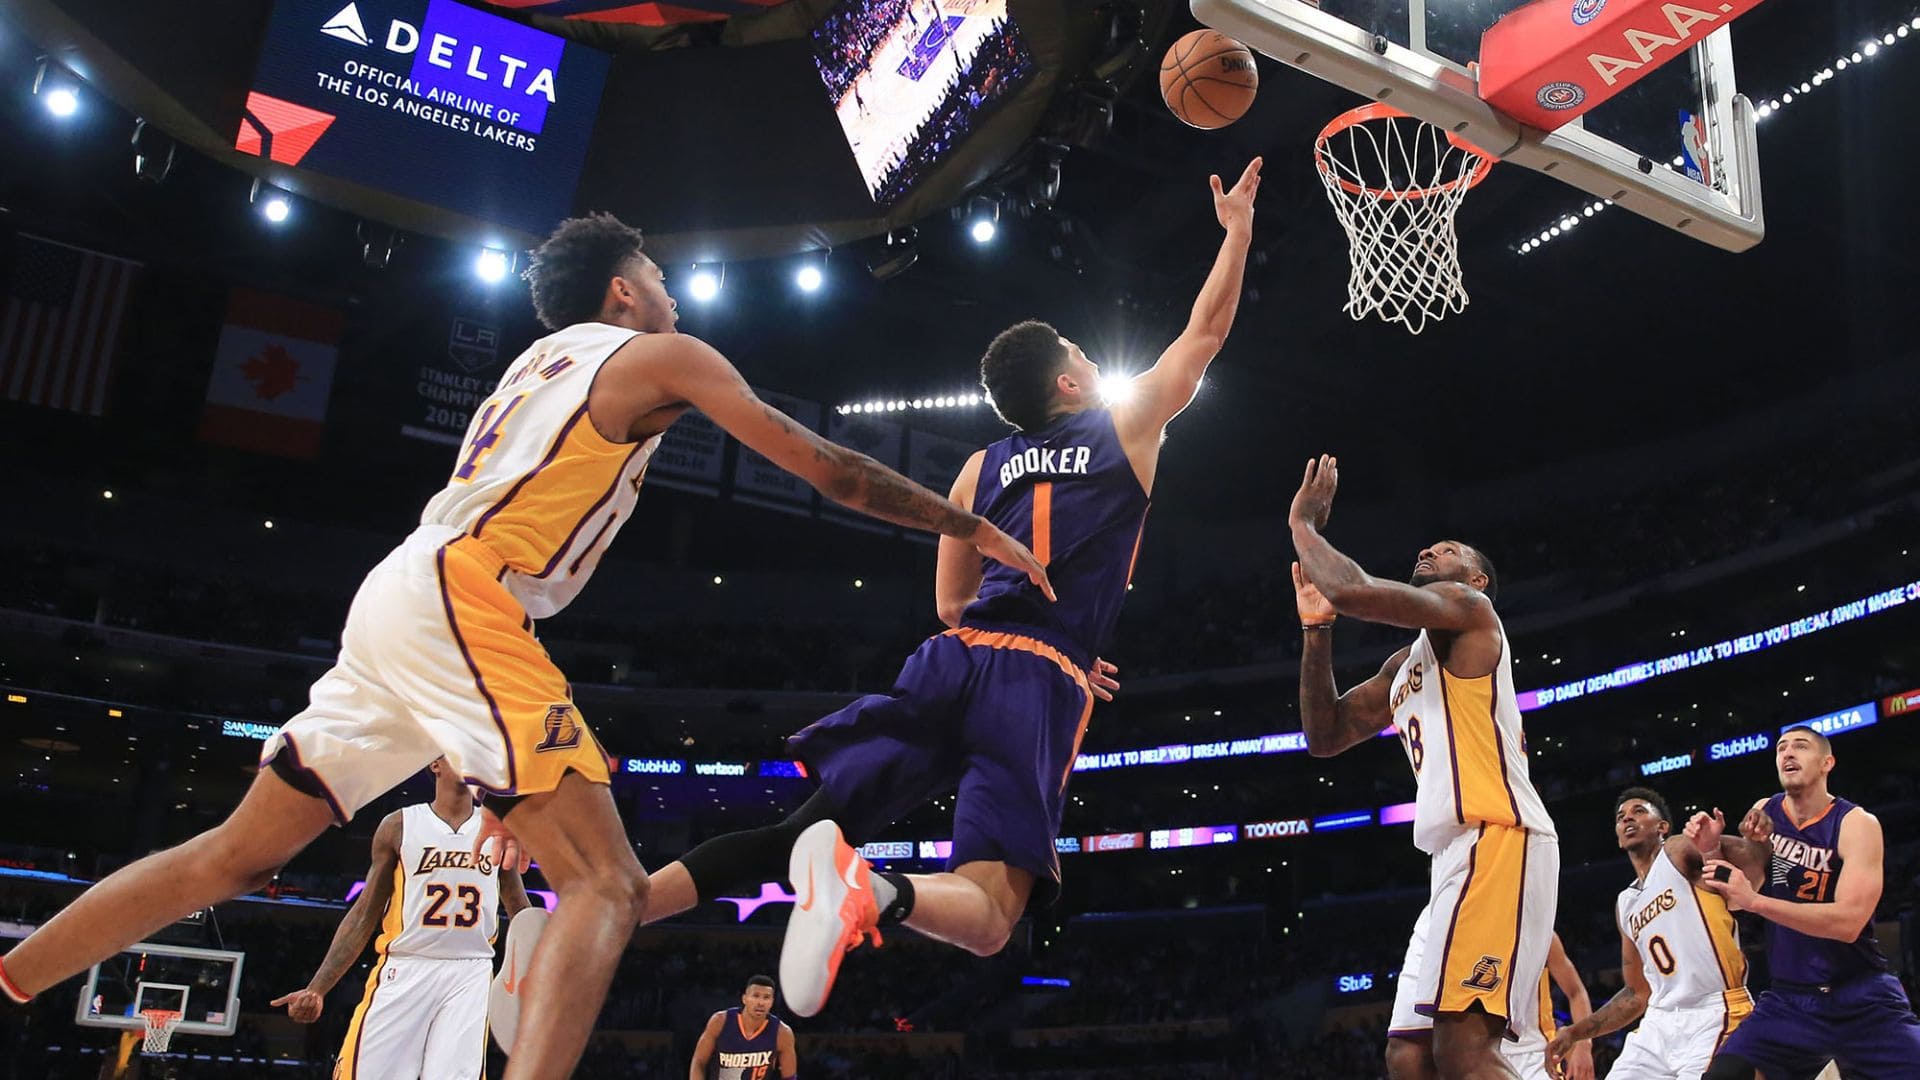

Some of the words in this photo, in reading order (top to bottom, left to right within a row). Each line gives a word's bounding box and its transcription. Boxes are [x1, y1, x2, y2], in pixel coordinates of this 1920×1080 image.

[385, 18, 556, 103] DELTA
[344, 60, 421, 97] OFFICIAL
[426, 86, 494, 120] AIRLINE
[496, 108, 521, 127] OF
[317, 72, 352, 96] THE
[355, 84, 389, 107] LOS
[392, 97, 470, 133] ANGELES
[474, 122, 536, 153] LAKERS
[418, 364, 482, 393] STANLEY
[424, 404, 469, 429] 2013
[1000, 446, 1091, 489] BOOKER
[1032, 481, 1052, 568] 1
[1555, 680, 1586, 702] DAILY
[1586, 662, 1655, 694] DEPARTURES
[1655, 652, 1690, 676] FROM
[1690, 645, 1714, 667] LAX
[1714, 640, 1733, 659] TO
[1733, 632, 1764, 655] HELP
[1764, 624, 1790, 646] YOU
[1790, 611, 1831, 639] BREAK
[1831, 599, 1867, 626] AWAY
[1868, 586, 1906, 613] MORE
[223, 720, 245, 734] SAN
[1101, 752, 1122, 768] LAX
[1123, 750, 1139, 765] TO
[1140, 748, 1167, 764] HELP
[1167, 745, 1191, 762] YOU
[1193, 741, 1229, 760] BREAK
[1229, 738, 1262, 756] AWAY
[1264, 735, 1297, 753] MORE
[1711, 733, 1769, 760] StubHub
[627, 759, 682, 774] StubHub
[695, 762, 745, 776] verizon
[1641, 752, 1692, 777] verizon
[1244, 819, 1310, 839] TOYOTA
[1769, 832, 1834, 873] HOENIX
[1796, 870, 1830, 902] 21
[422, 884, 481, 928] 23
[1648, 935, 1676, 976] 0
[719, 1050, 773, 1068] PHOENIX
